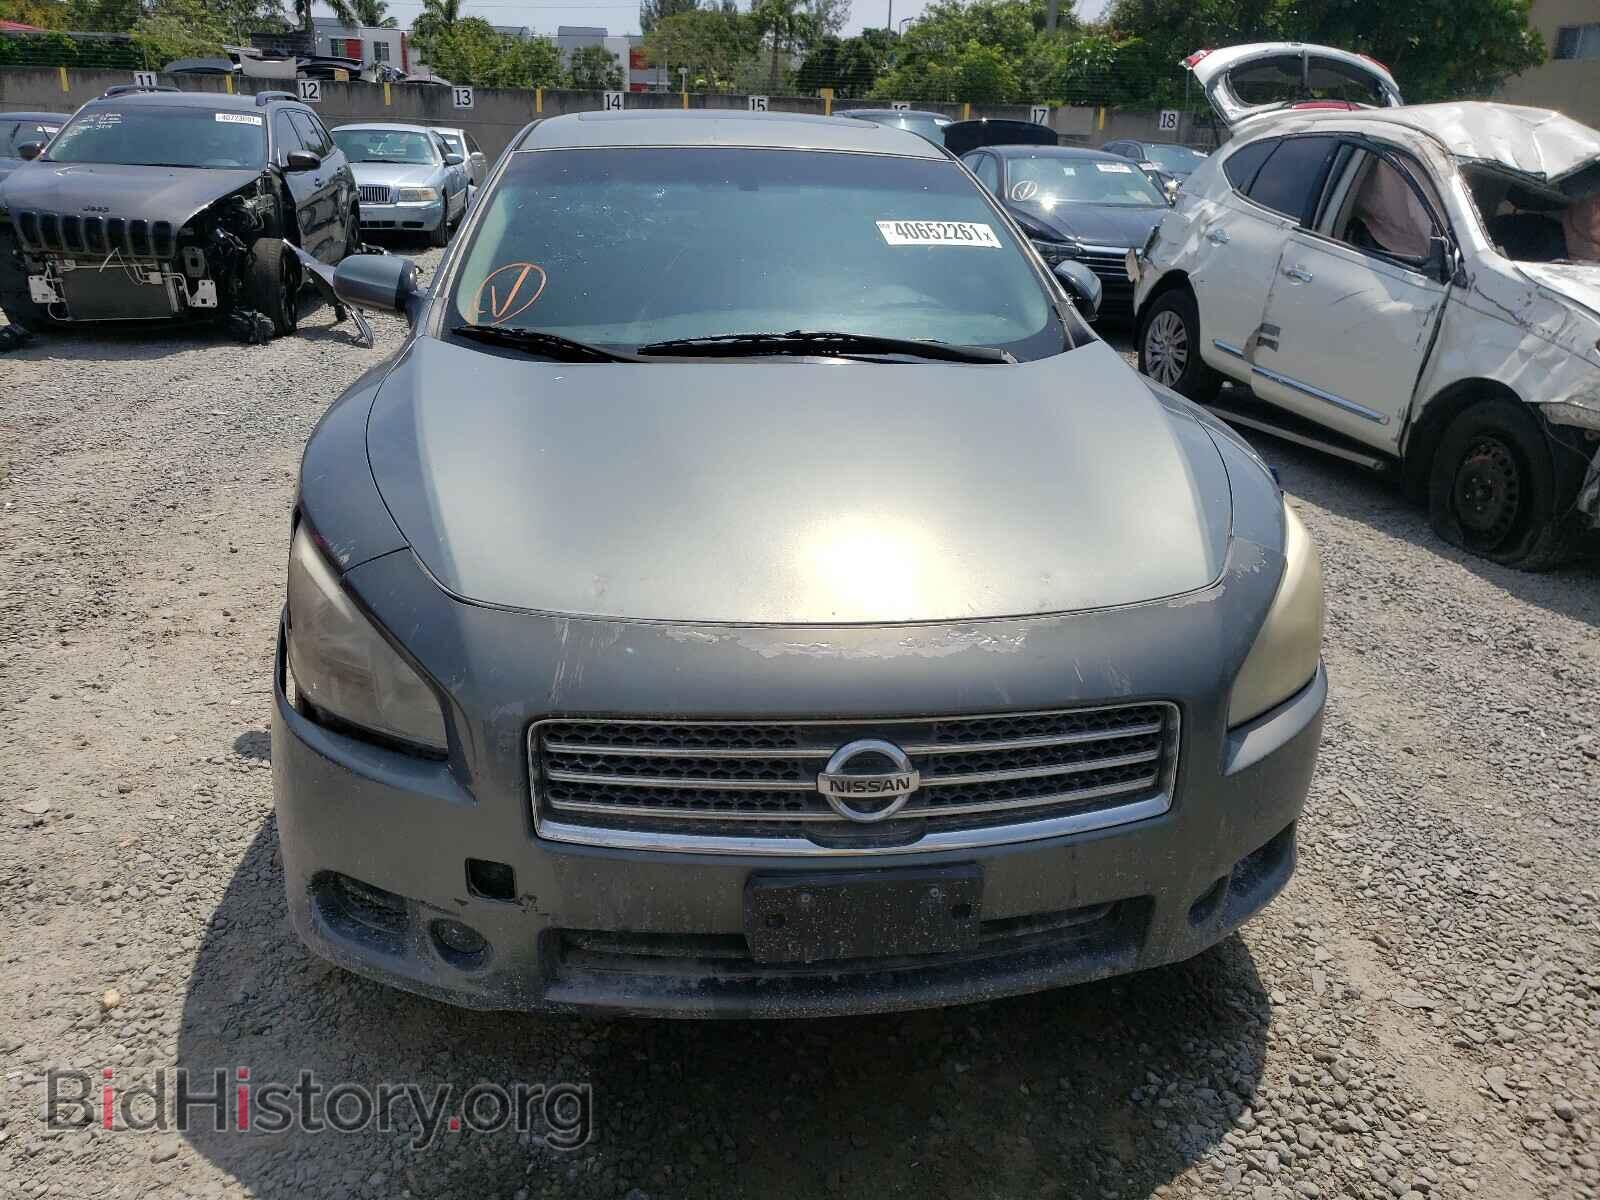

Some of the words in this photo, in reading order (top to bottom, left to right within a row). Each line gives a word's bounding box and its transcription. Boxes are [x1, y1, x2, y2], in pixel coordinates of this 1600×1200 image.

[138, 74, 153, 86] 11
[301, 83, 318, 99] 12
[455, 90, 471, 105] 13
[606, 94, 622, 110] 14
[751, 98, 766, 112] 15
[1033, 109, 1047, 124] 17
[1162, 113, 1176, 128] 18
[895, 222, 982, 241] 40652261
[830, 777, 910, 793] NISSAN
